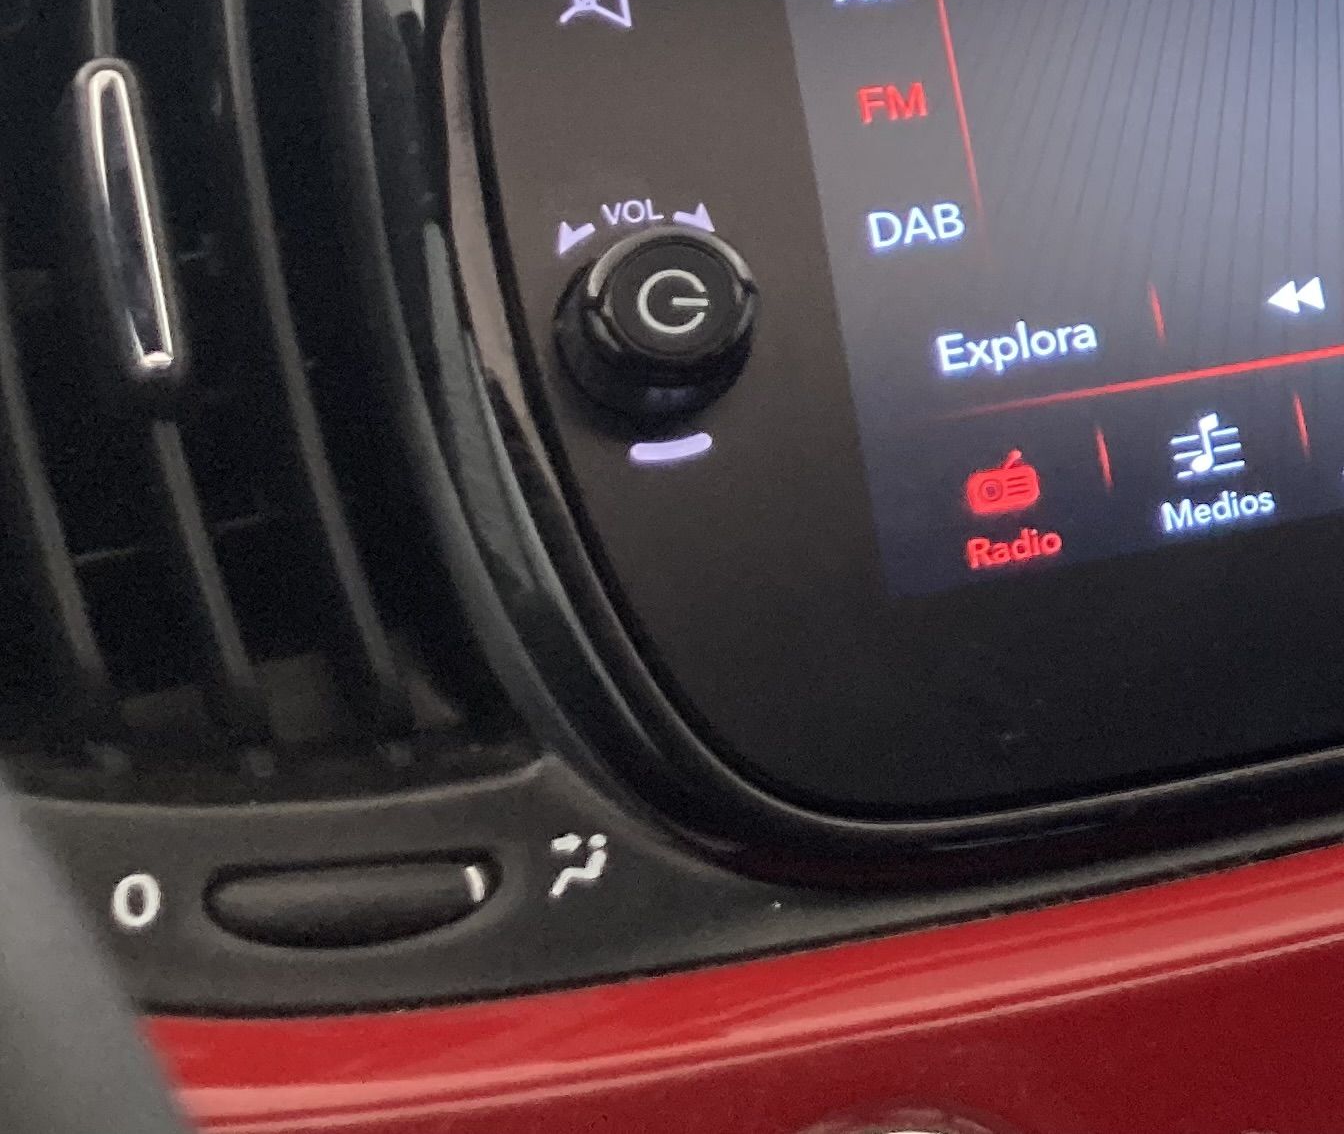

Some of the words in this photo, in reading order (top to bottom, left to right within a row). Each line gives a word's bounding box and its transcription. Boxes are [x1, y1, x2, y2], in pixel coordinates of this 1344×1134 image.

[856, 82, 928, 124] FM
[600, 199, 664, 225] VOL
[868, 202, 965, 250] DAB
[936, 318, 1098, 373] Explora
[1161, 489, 1276, 532] Medios
[966, 529, 1062, 571] Radio
